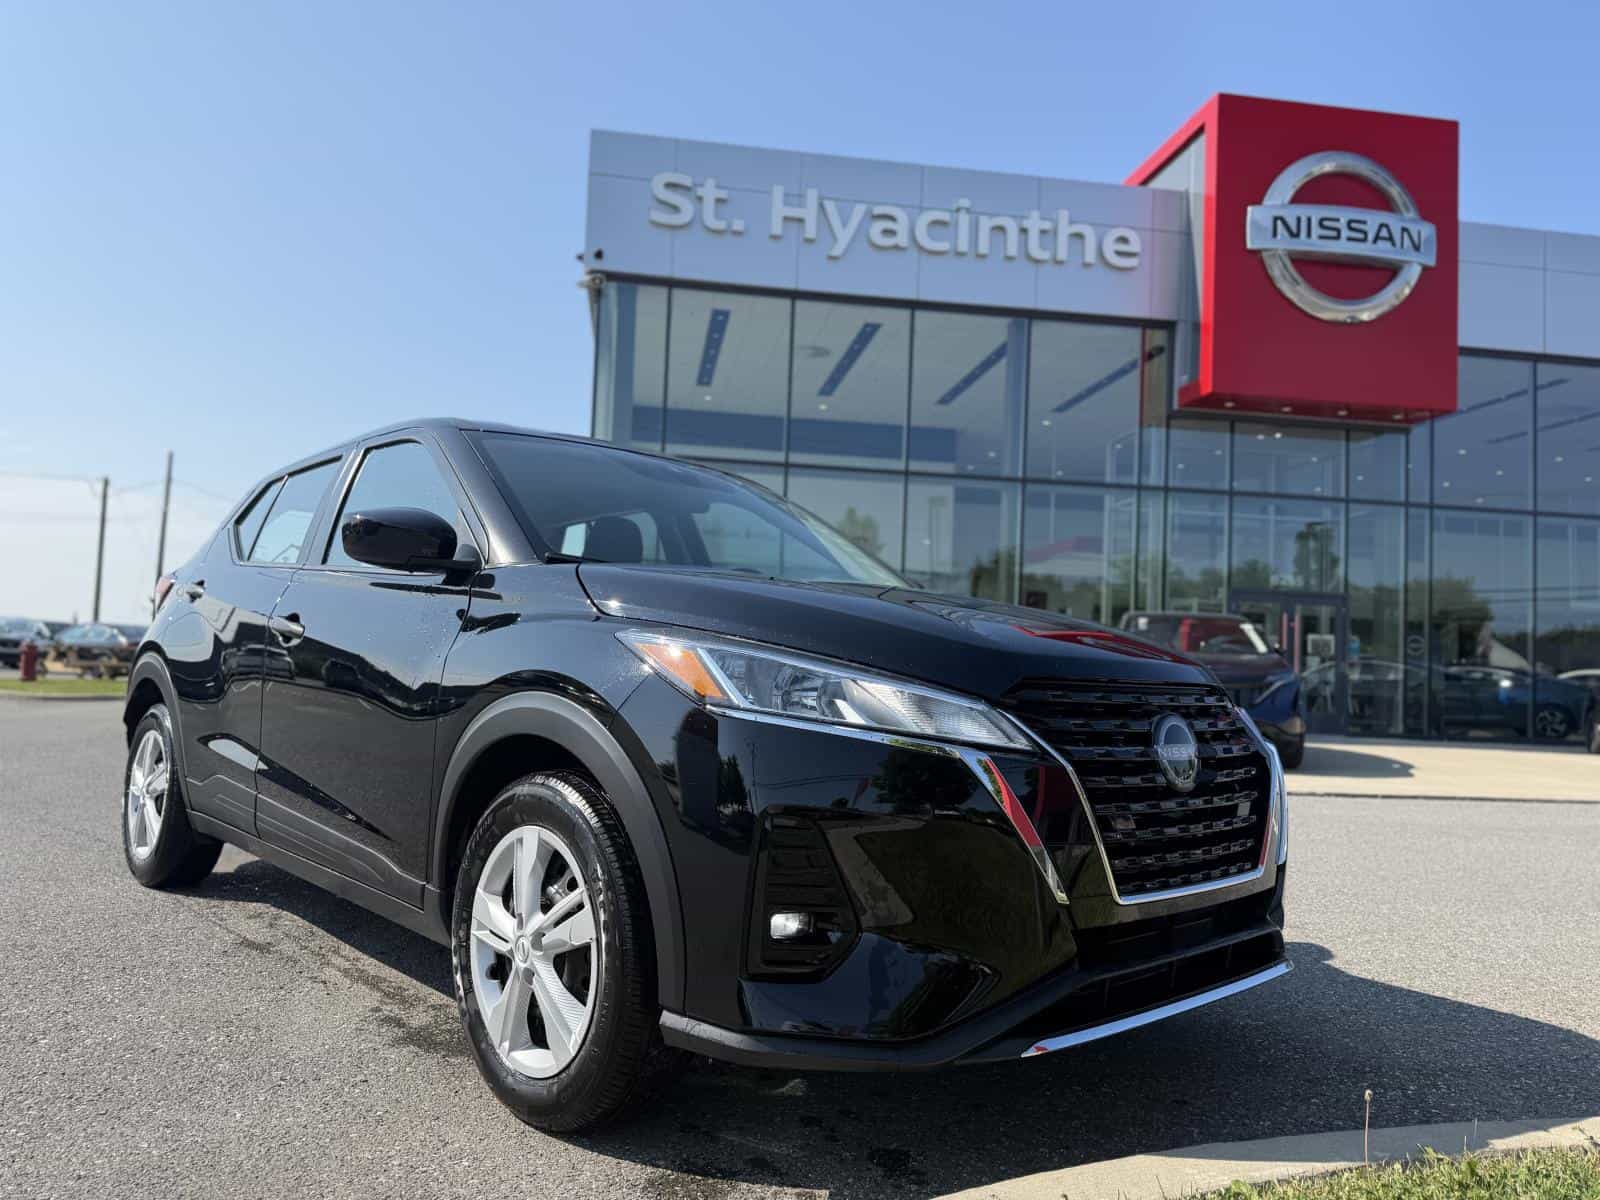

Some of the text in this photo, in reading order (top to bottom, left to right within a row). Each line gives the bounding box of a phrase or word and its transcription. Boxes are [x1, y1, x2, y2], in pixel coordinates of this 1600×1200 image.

[648, 171, 1142, 271] St. Hyacinthe
[1271, 215, 1424, 253] NISSAN
[1159, 745, 1194, 759] NISS
